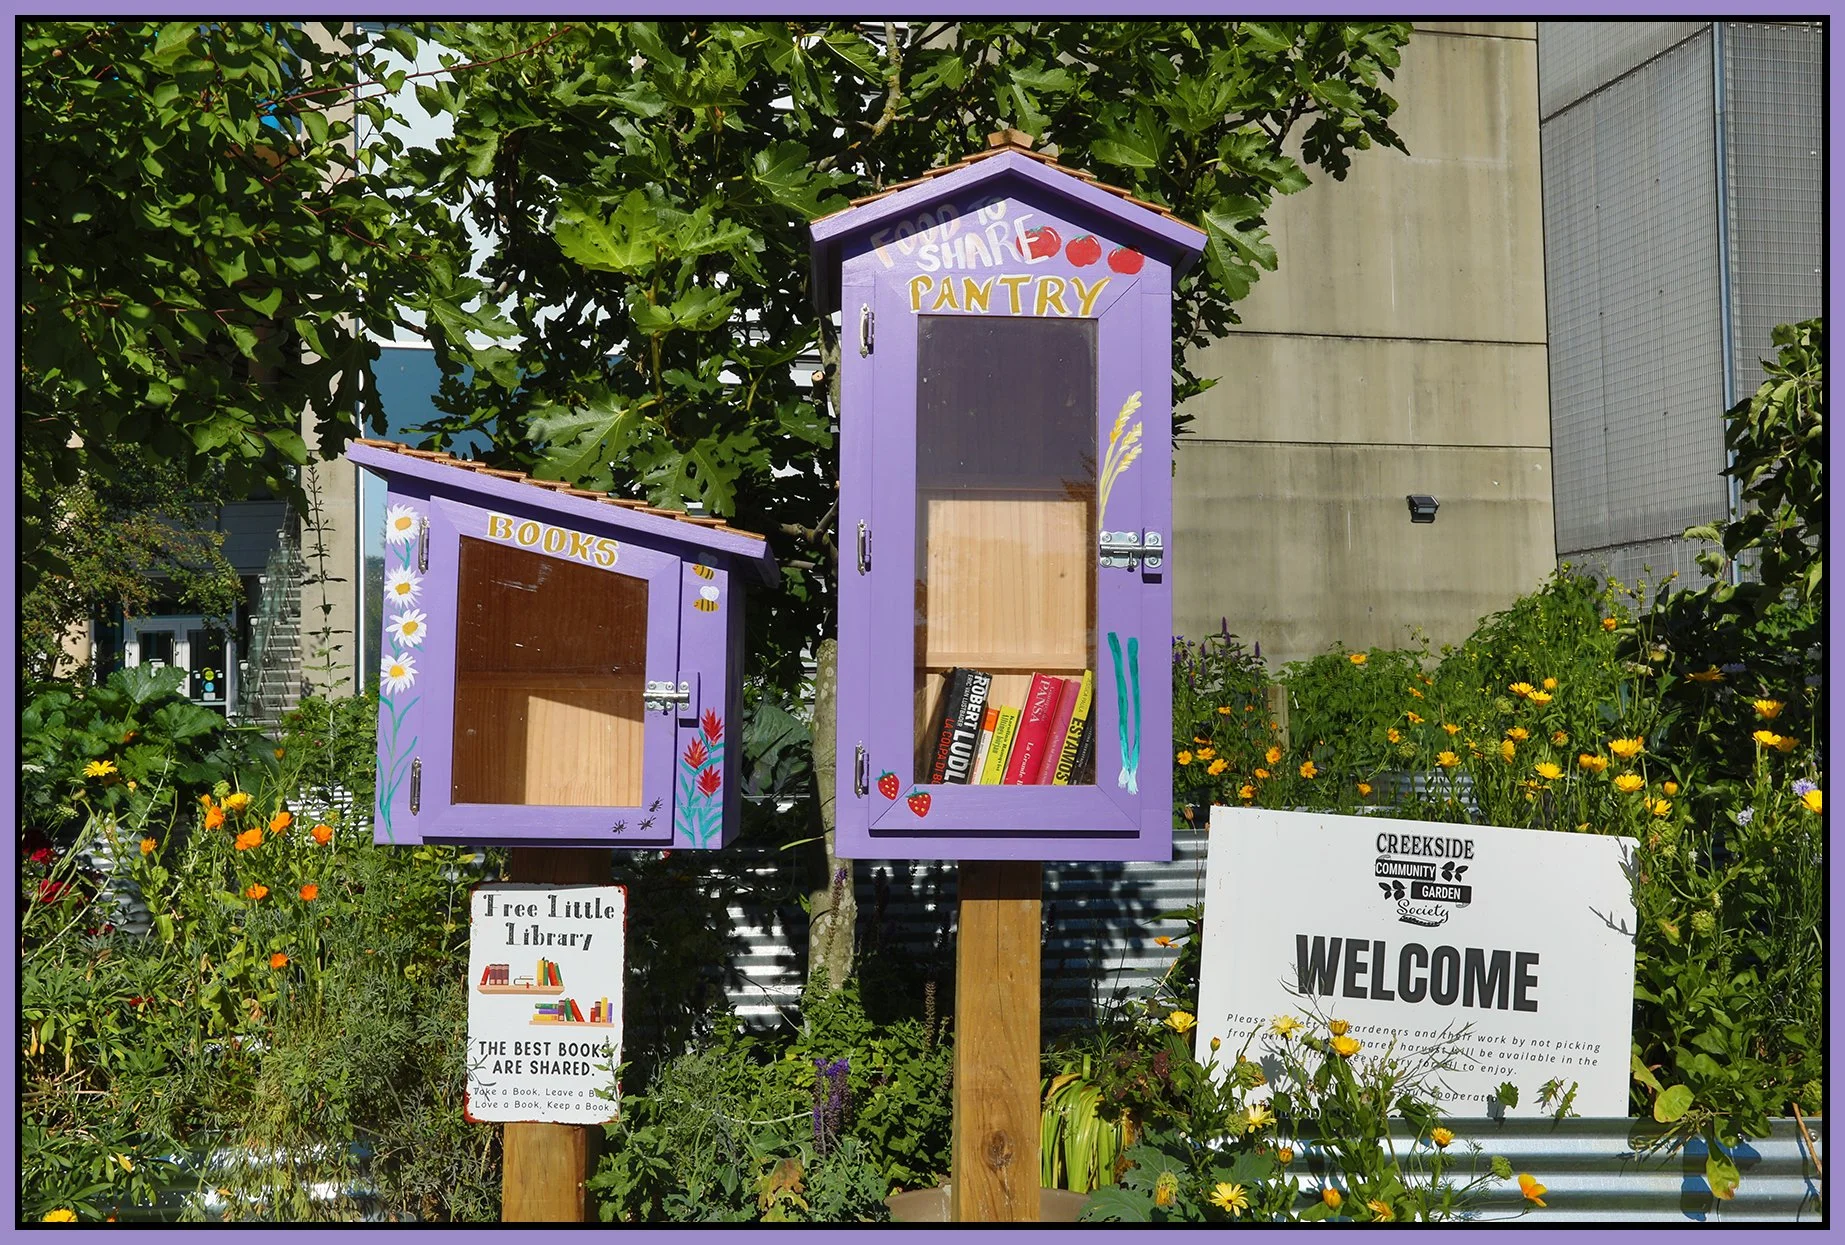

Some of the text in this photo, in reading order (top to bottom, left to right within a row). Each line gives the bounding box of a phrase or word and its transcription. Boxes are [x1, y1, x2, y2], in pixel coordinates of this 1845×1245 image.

[869, 196, 1009, 269] FOOD TO
[916, 213, 1051, 272] SHARE
[906, 273, 1112, 318] PANTRY
[484, 511, 620, 569] BOOKS
[964, 674, 990, 730] ROBERT
[1030, 679, 1051, 723] PANSA
[944, 718, 955, 729] LA
[937, 730, 953, 761] COLPA
[1026, 741, 1035, 752] La
[1056, 717, 1086, 782] ESTAMOS
[934, 761, 946, 773] DI
[1019, 751, 1032, 778] Grande
[1376, 833, 1475, 860] CREEKSIDE
[1376, 861, 1436, 878] COMMUNITY
[1422, 885, 1461, 900] GARDEN
[483, 893, 615, 920] Free Little
[1396, 899, 1449, 923] Society
[505, 922, 593, 951] Library
[1296, 934, 1540, 1013] WELCOME
[1227, 1013, 1266, 1025] Please
[1347, 1024, 1409, 1037] gardeners
[1414, 1030, 1437, 1039] and
[1477, 1035, 1507, 1044] work
[1512, 1036, 1526, 1047] by
[1531, 1039, 1551, 1048] not
[1555, 1040, 1601, 1053] picking
[478, 1041, 507, 1056] THE
[514, 1041, 552, 1057] BEST
[1226, 1028, 1256, 1039] from
[1479, 1048, 1493, 1058] be
[1499, 1050, 1556, 1063] available
[1561, 1055, 1573, 1064] in
[1578, 1057, 1598, 1067] the
[492, 1060, 595, 1077] ARE SHARED.
[1463, 1063, 1475, 1071] to
[1480, 1064, 1517, 1077] enjoy.
[473, 1087, 497, 1096] Take
[512, 1087, 541, 1097] Book,
[545, 1088, 574, 1097] Leave
[578, 1090, 584, 1098] a
[475, 1100, 498, 1109] Love
[514, 1100, 542, 1110] Book,
[547, 1100, 571, 1111] Keep
[585, 1102, 612, 1112] Book.
